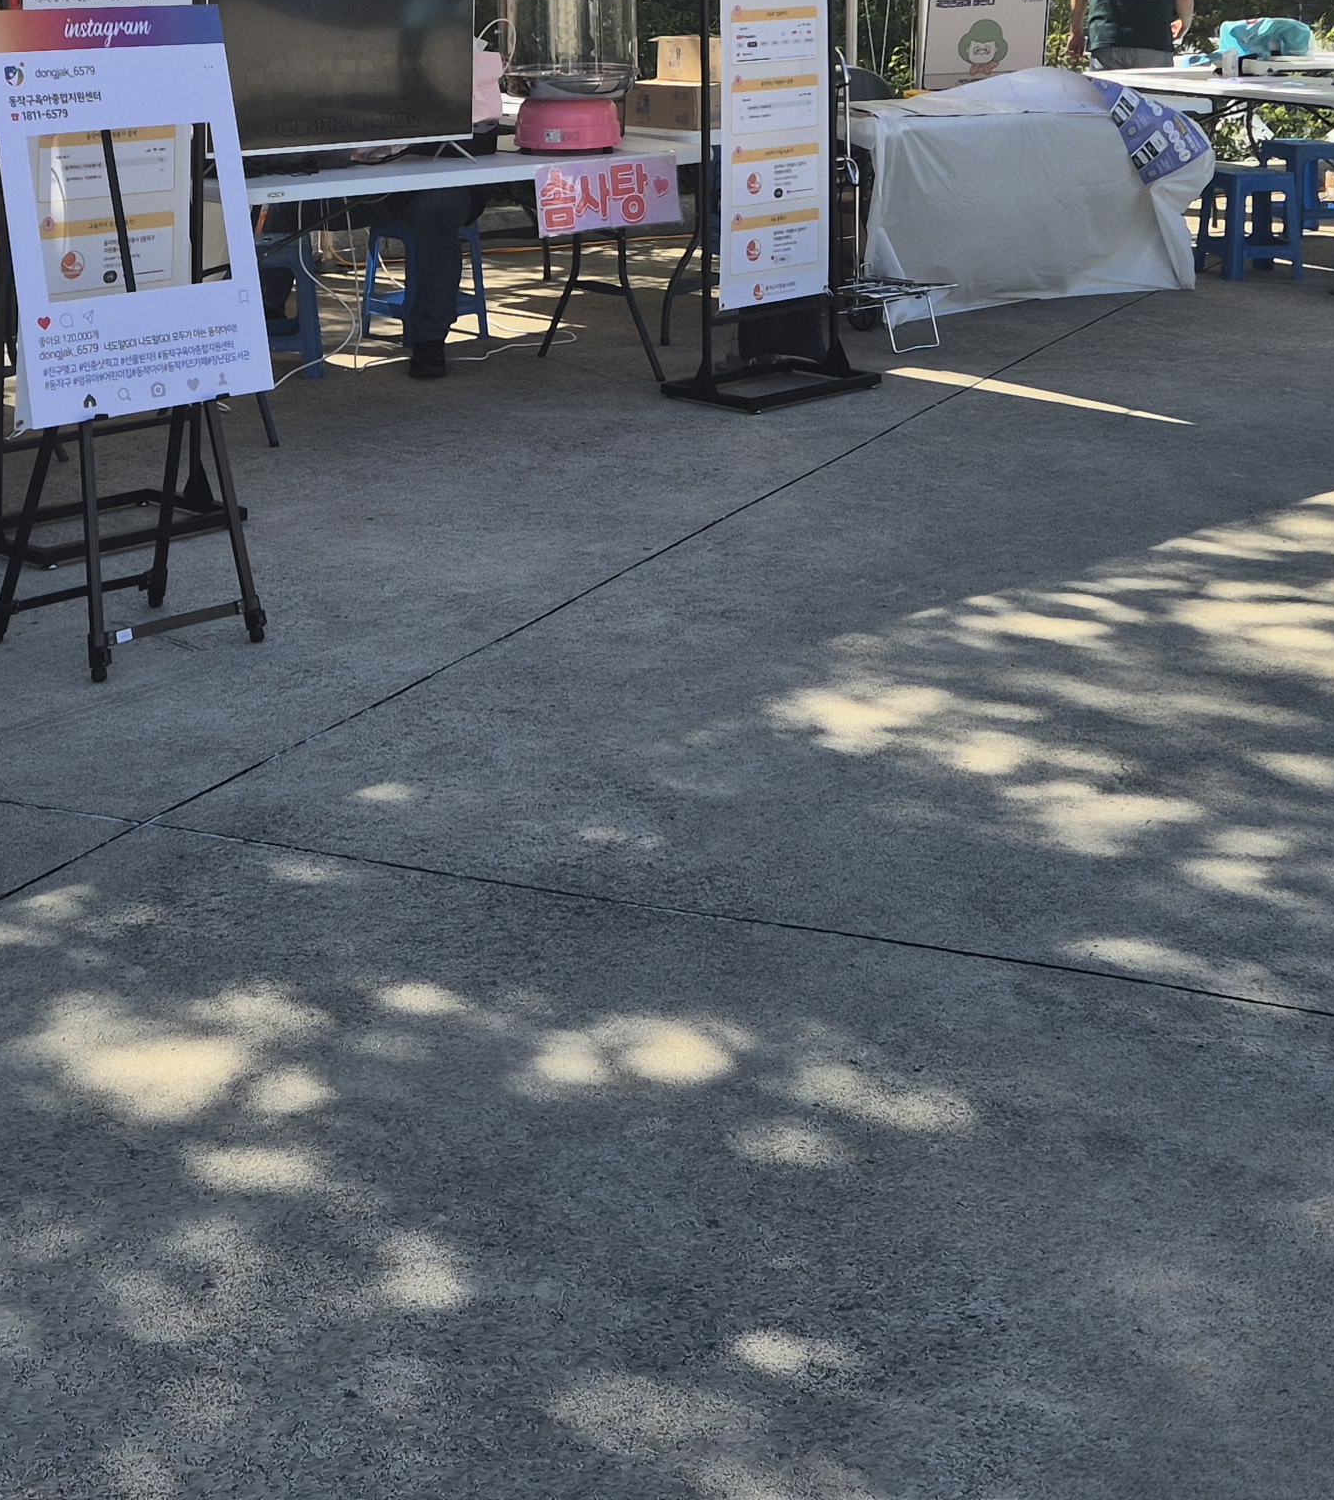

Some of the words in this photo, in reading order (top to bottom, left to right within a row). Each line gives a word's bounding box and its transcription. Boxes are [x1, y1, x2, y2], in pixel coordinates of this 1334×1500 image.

[64, 18, 152, 48] instagram
[35, 65, 96, 79] dongjak_6579
[8, 90, 102, 108] 동작구육아종합지원센터
[21, 108, 69, 121] 1811-6579
[539, 162, 650, 232] 솜사탕
[38, 334, 62, 348] 좋아요
[38, 342, 99, 361] dongjak_6579
